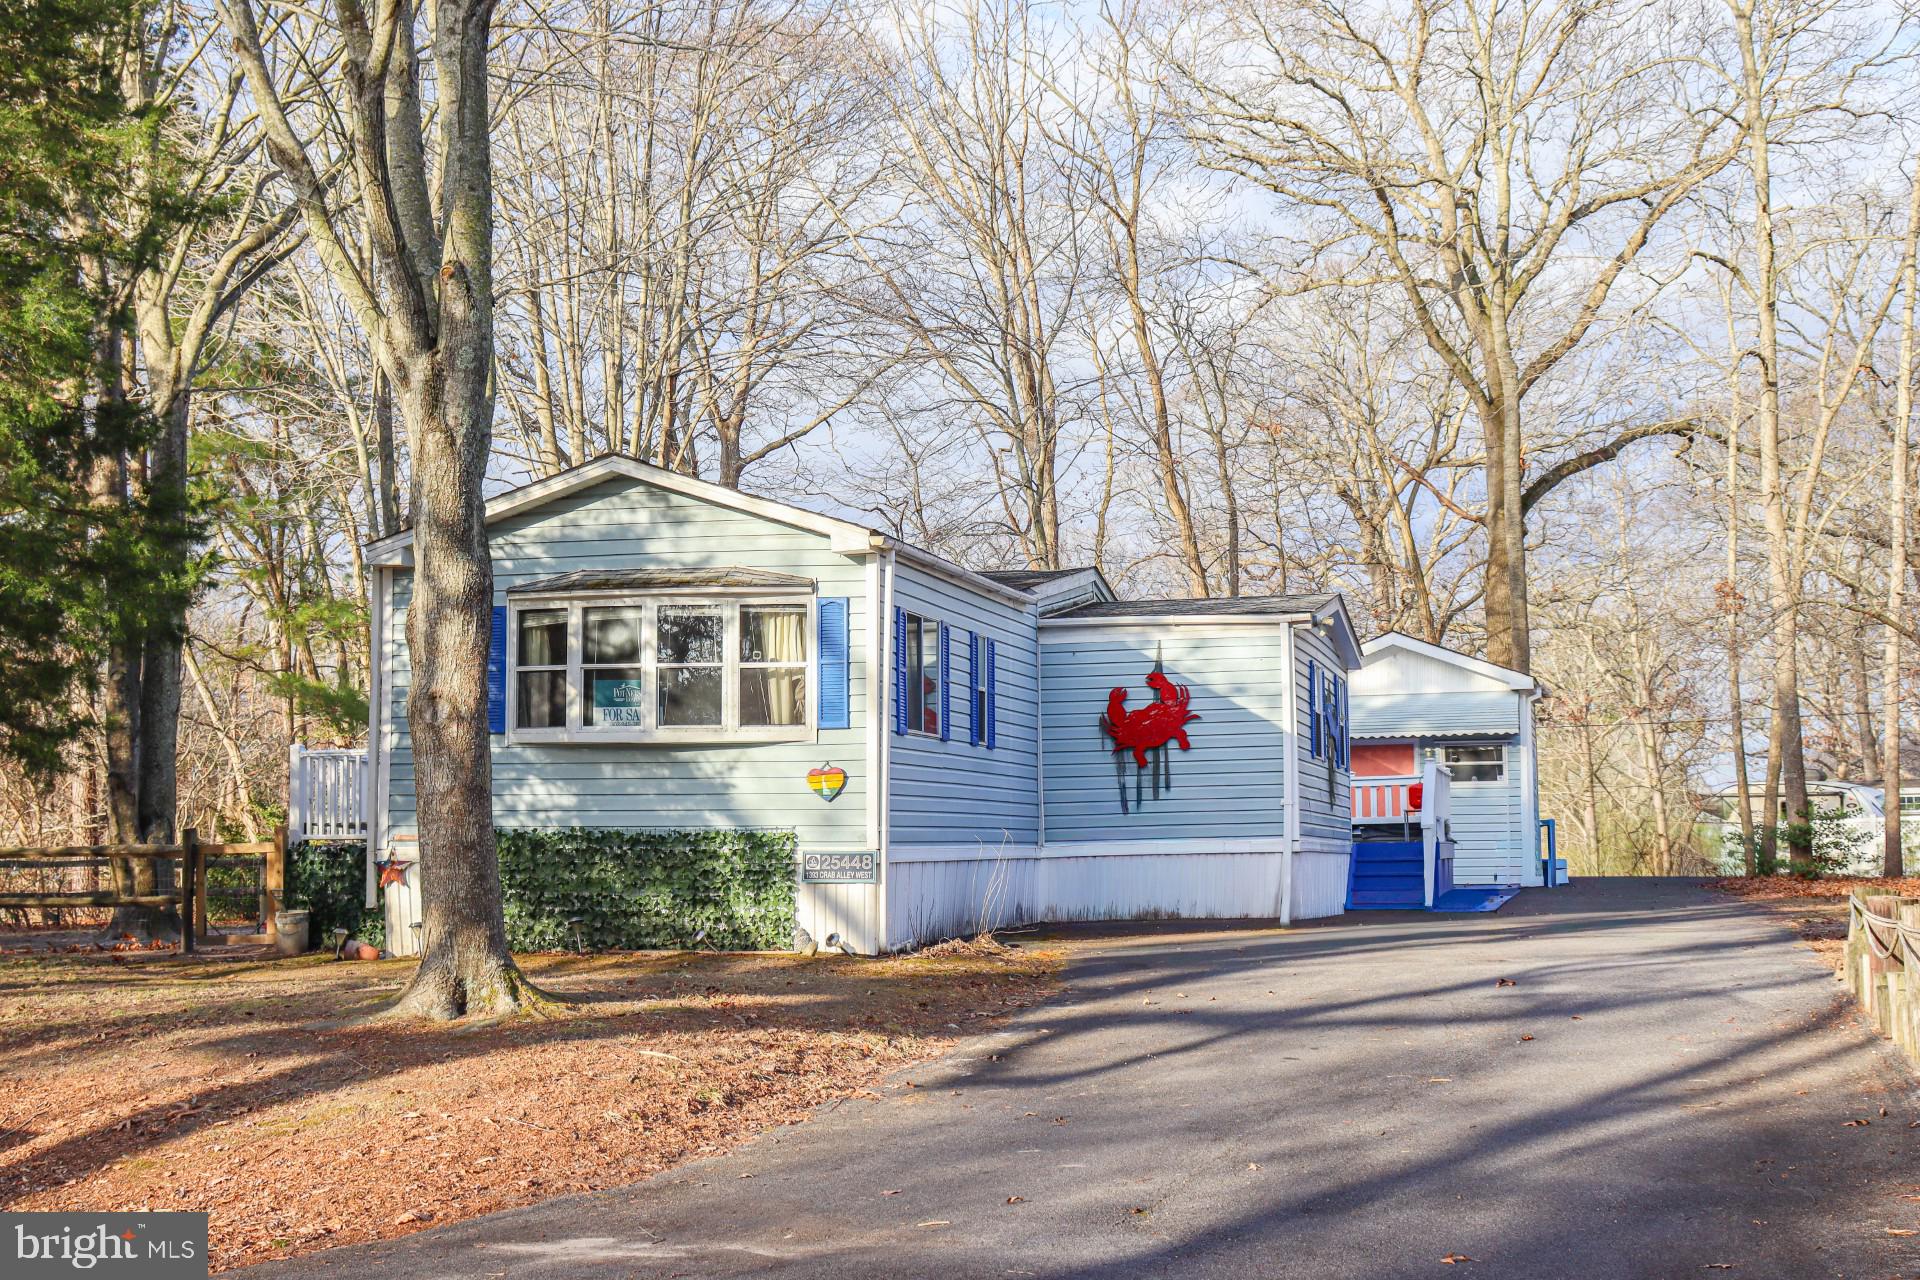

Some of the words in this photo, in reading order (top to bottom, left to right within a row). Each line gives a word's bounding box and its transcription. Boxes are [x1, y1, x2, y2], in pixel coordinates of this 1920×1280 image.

[603, 708, 623, 721] FOR
[626, 708, 640, 721] SA
[821, 854, 873, 870] 25448
[806, 871, 819, 879] 1393
[819, 871, 836, 879] CRAB
[836, 871, 855, 879] ALLEY
[855, 871, 872, 879] WEST
